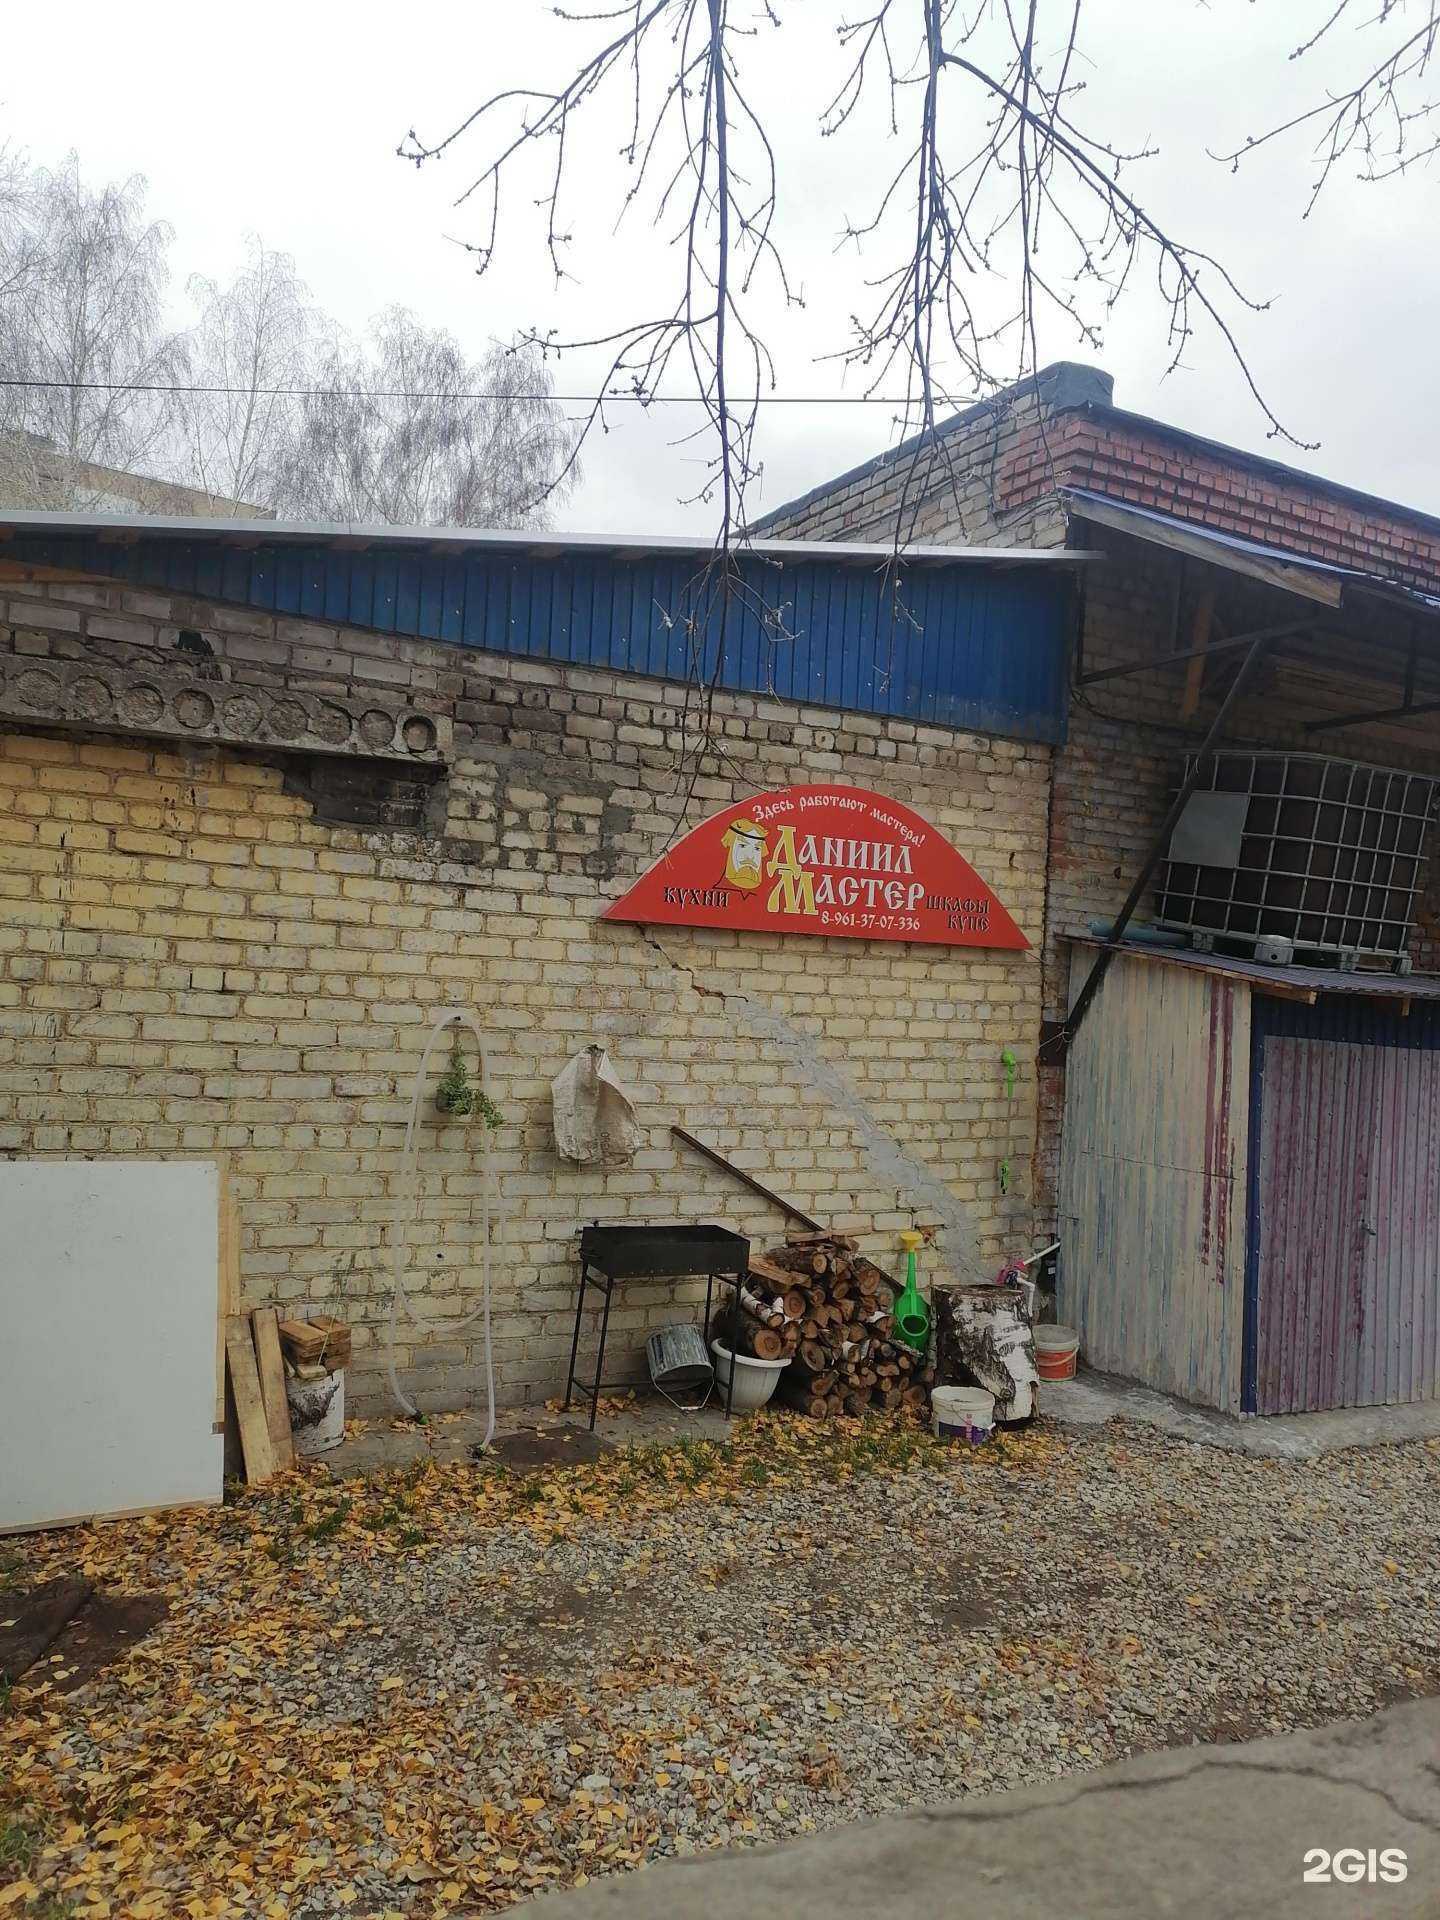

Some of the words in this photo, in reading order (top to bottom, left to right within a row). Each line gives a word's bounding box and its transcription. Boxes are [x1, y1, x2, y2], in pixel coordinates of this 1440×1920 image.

[752, 799, 795, 822] Здесь
[799, 795, 867, 813] работают
[870, 807, 926, 848] мастера!
[821, 911, 920, 931] 8-961-37-07-336
